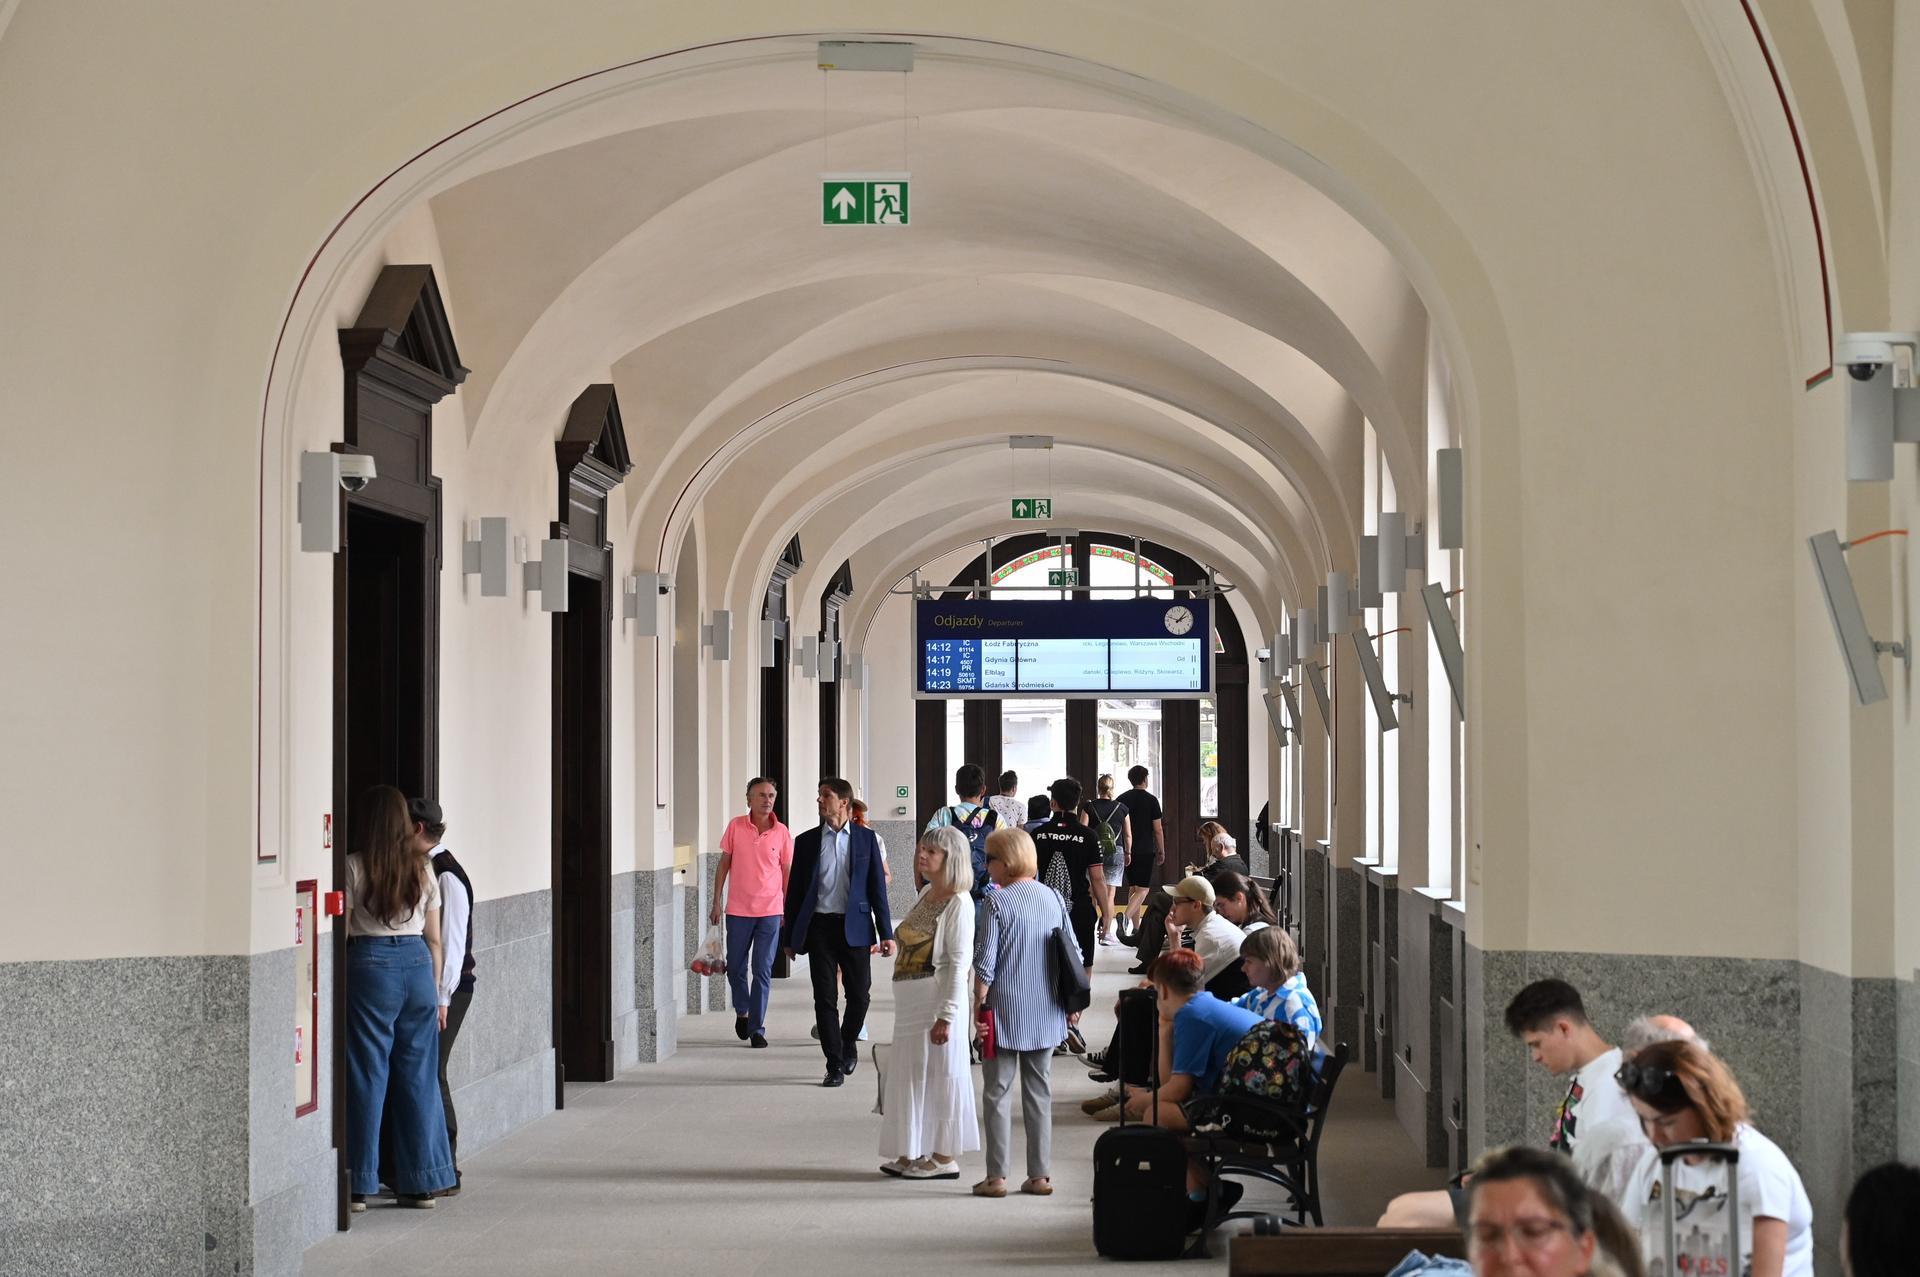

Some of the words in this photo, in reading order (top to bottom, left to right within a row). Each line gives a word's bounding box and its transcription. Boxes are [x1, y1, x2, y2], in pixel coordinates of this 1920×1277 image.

[934, 614, 984, 629] Odjazdy
[988, 619, 1024, 628] Departures
[926, 642, 951, 652] 14:12
[926, 655, 951, 664] 14:17
[984, 656, 1008, 665] Gdynia
[926, 668, 951, 677] 14:19
[926, 681, 951, 690] 14:23
[1011, 680, 1055, 688] Śródmieście
[1037, 833, 1084, 843] PETRONAS
